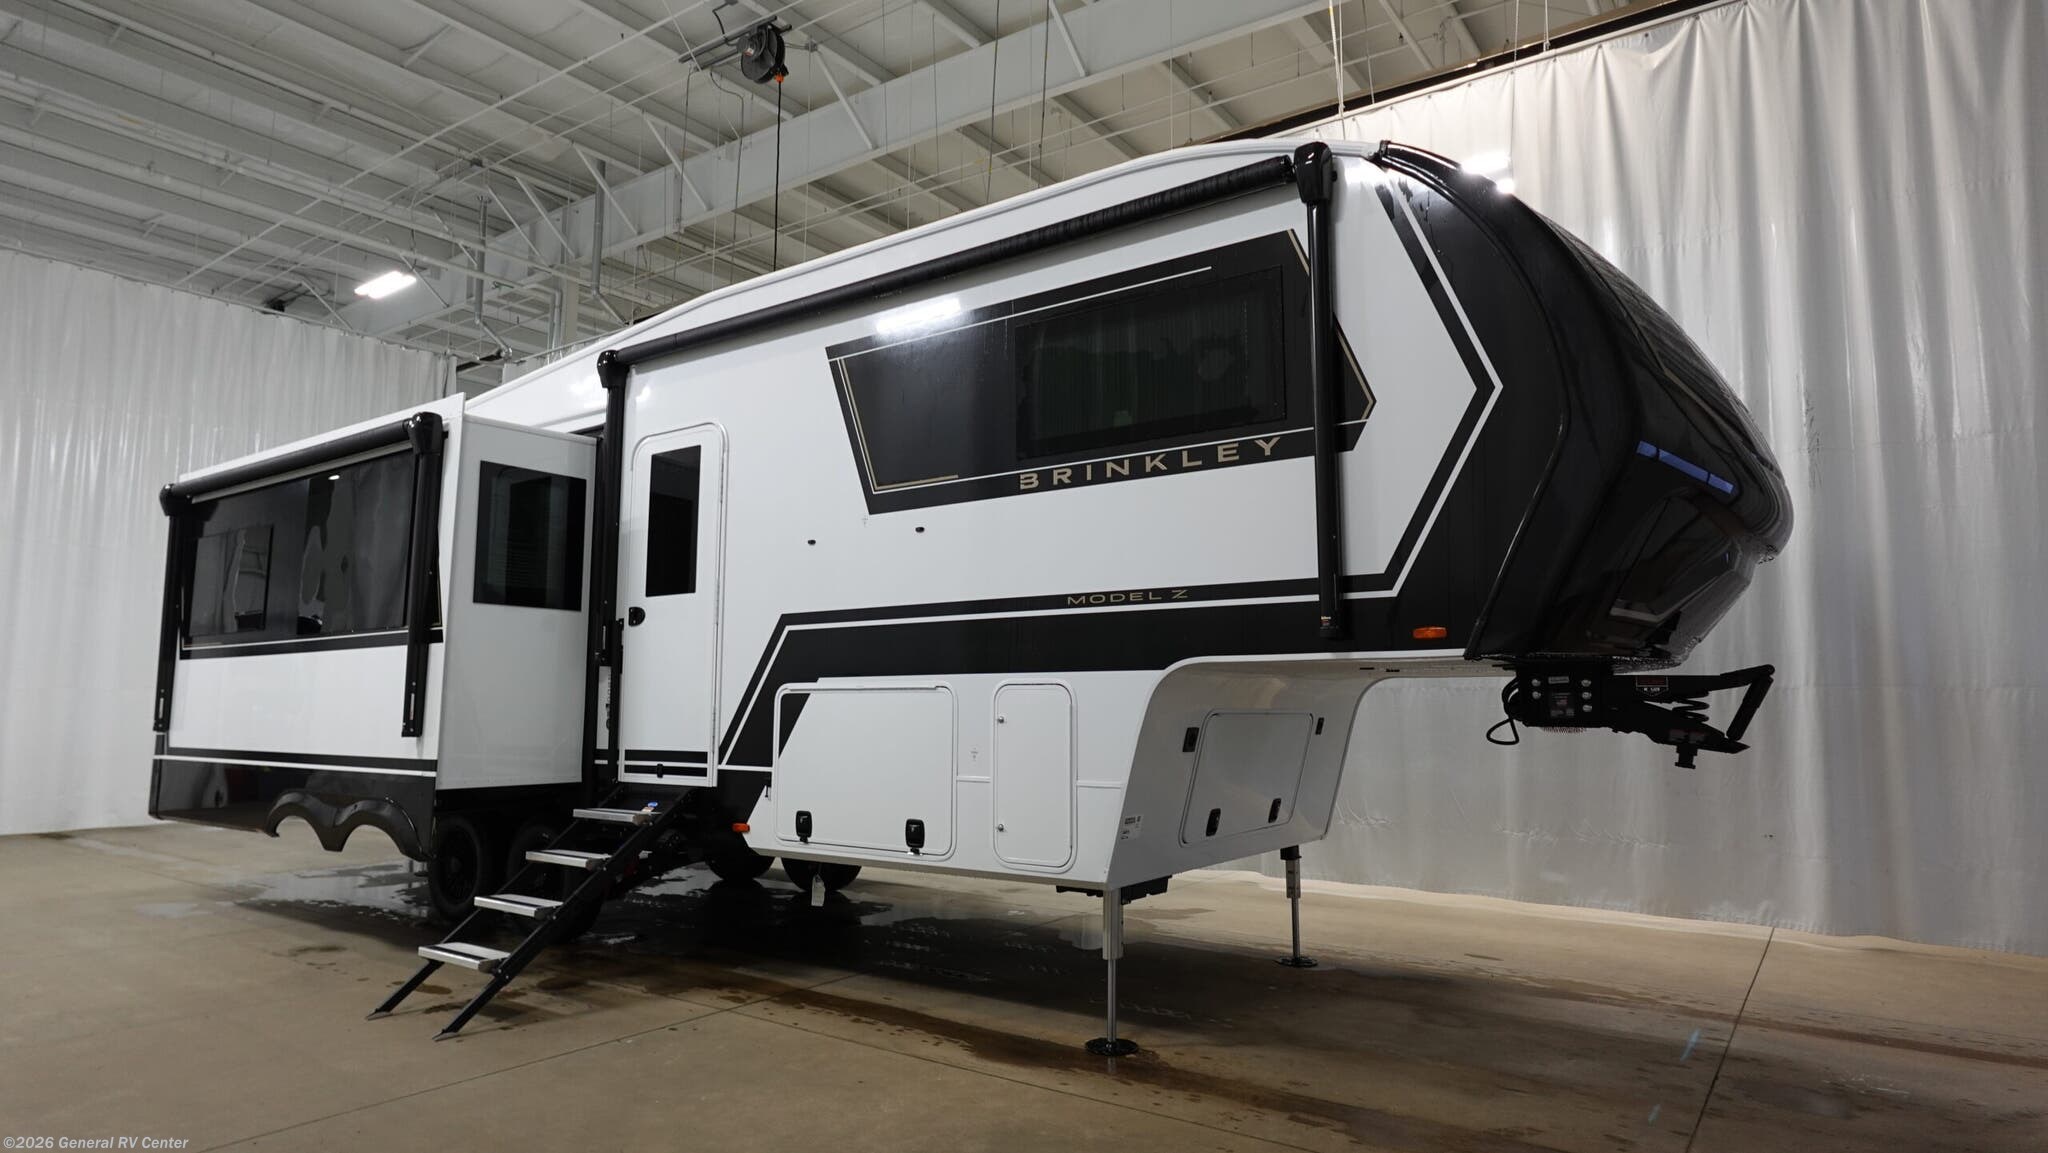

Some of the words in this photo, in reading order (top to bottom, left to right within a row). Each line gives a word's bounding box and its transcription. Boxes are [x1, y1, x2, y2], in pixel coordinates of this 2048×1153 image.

[1019, 436, 1281, 490] BRINKLEY
[1067, 591, 1162, 606] MODEL
[1171, 589, 1188, 600] Z
